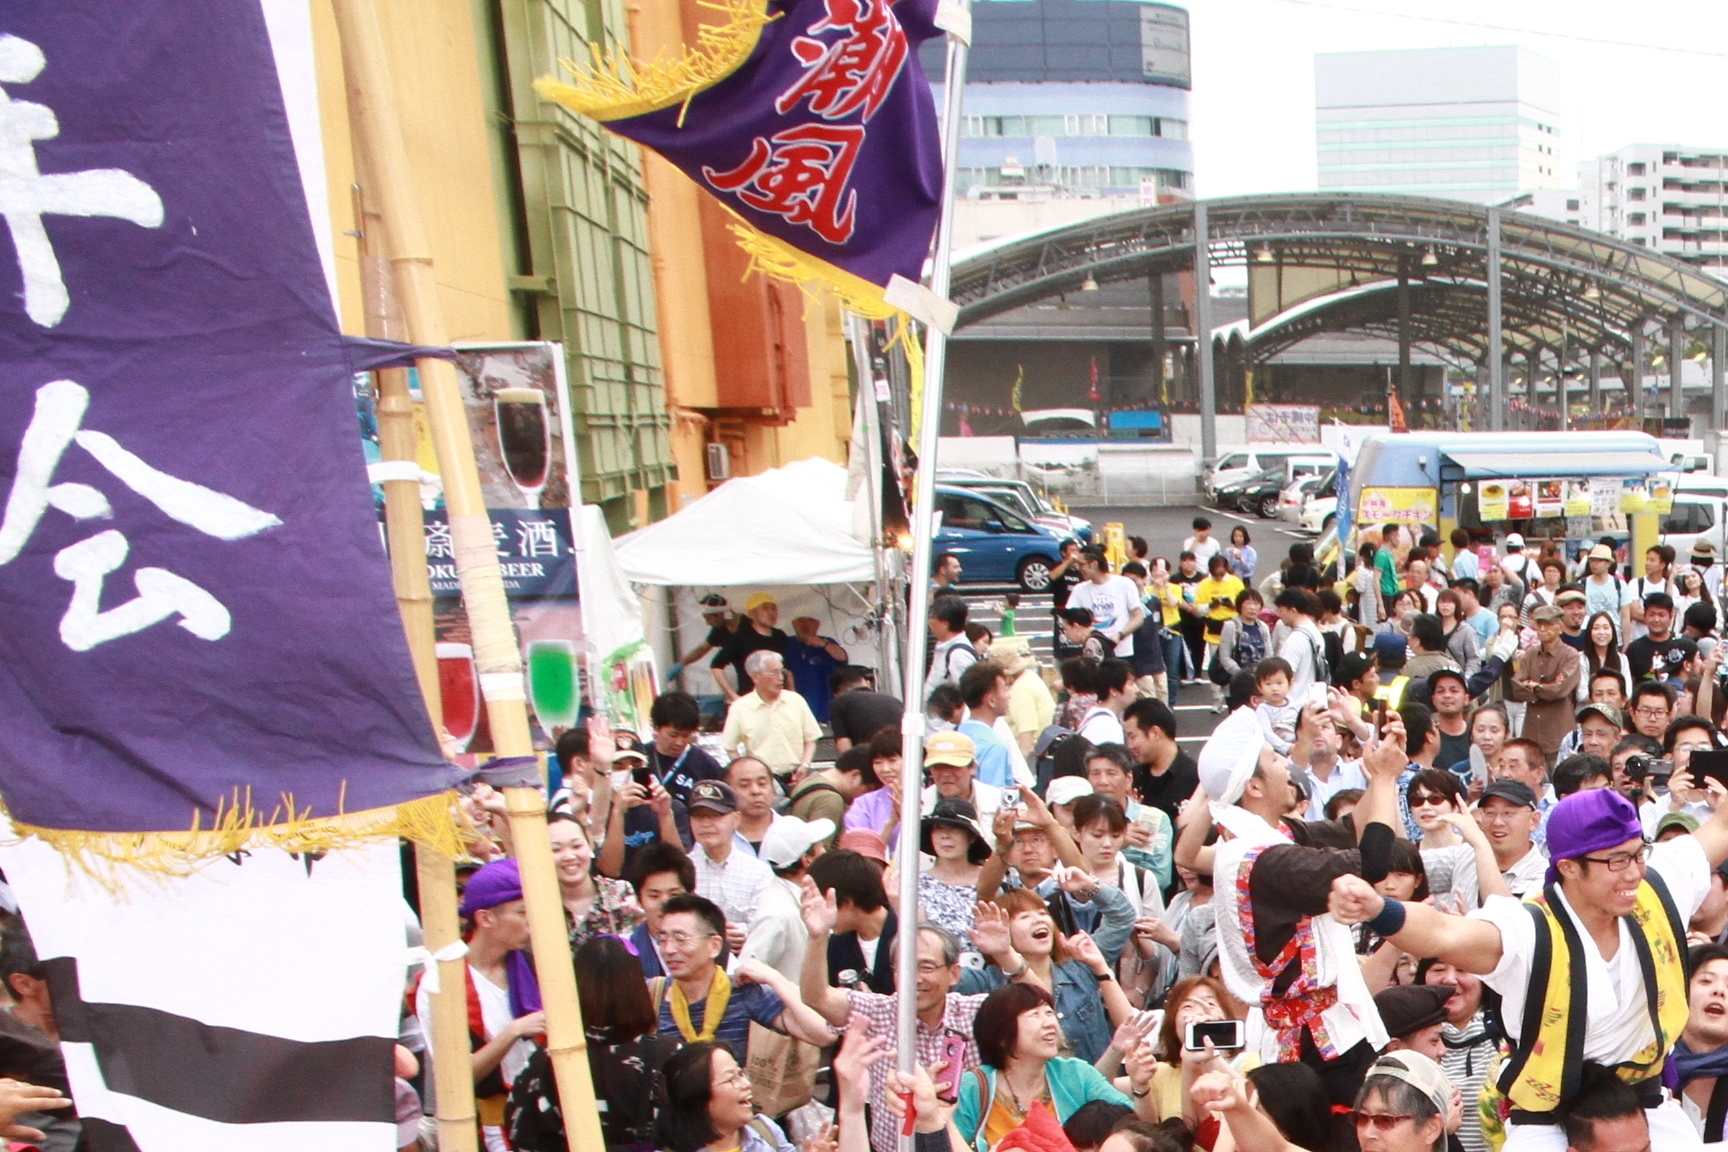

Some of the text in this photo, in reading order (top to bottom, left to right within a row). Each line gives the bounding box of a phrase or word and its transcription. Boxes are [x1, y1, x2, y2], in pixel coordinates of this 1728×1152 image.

[1363, 510, 1433, 520] スモークチキン
[500, 562, 546, 577] BEER
